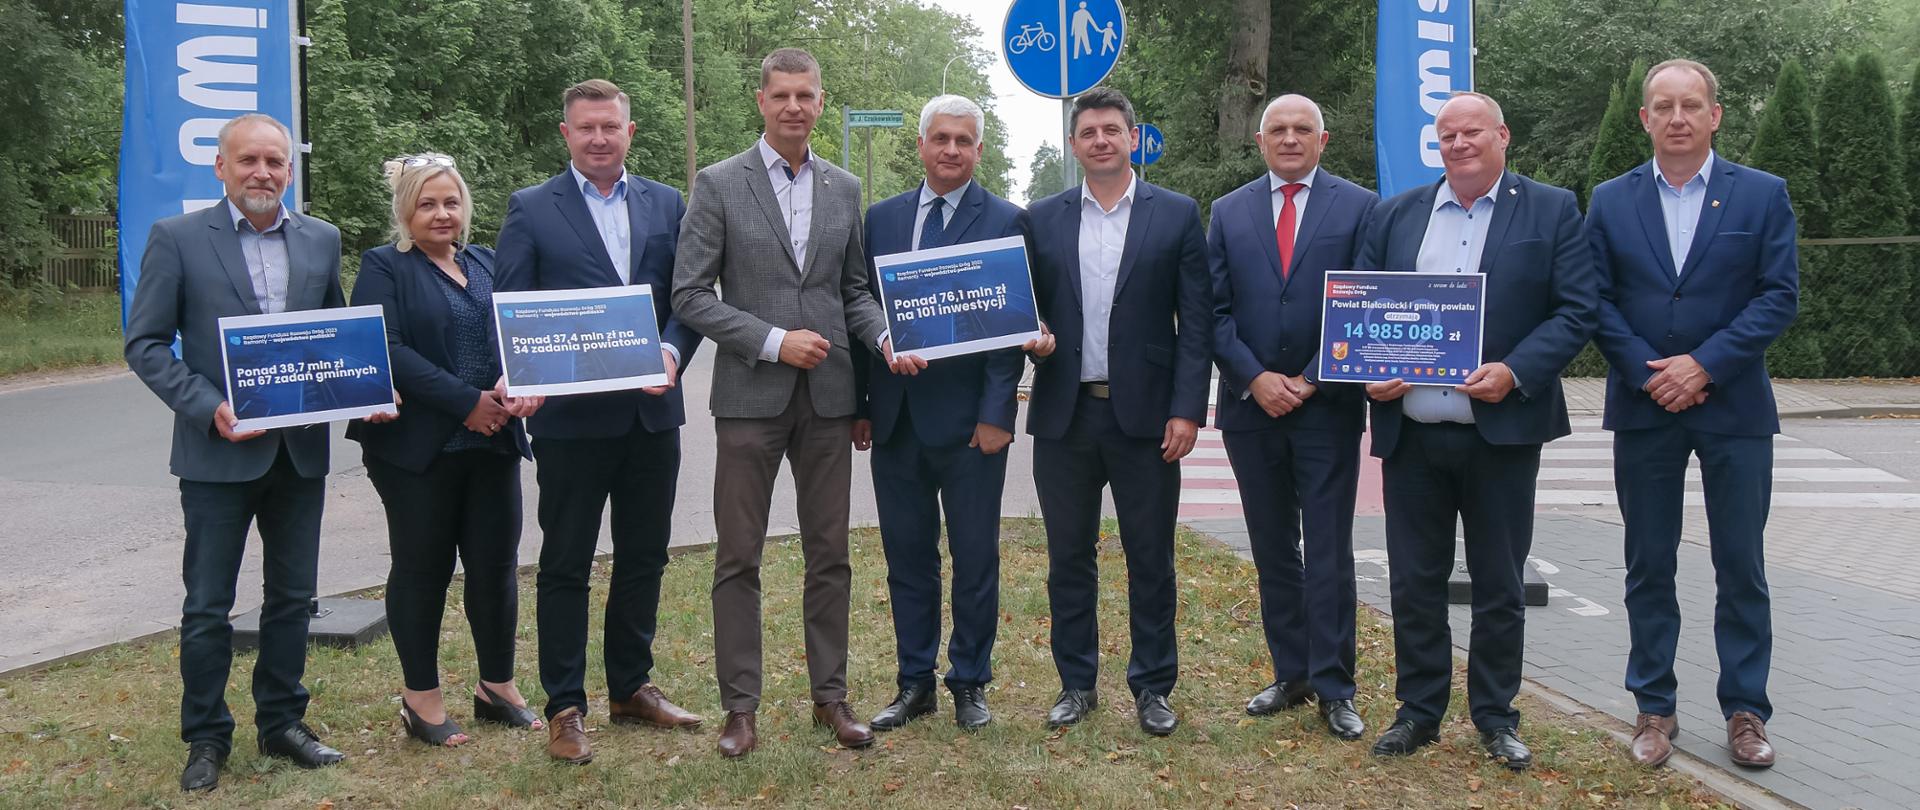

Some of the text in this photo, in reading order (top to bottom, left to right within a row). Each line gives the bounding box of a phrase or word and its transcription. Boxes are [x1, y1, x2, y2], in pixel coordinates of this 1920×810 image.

[894, 283, 1007, 310] Ponad 76,1 mln zł
[1332, 300, 1360, 309] Powiat
[1361, 300, 1407, 310] Białostocki
[1414, 302, 1439, 311] gminy
[1441, 303, 1475, 312] powiatu
[897, 294, 1007, 321] na 101 inwestycji
[512, 329, 635, 345] Ponad 37,4 mln zł na
[1344, 322, 1460, 341] 14 985 088 zł
[513, 337, 648, 354] 34 zadania powiatowe
[237, 358, 344, 378] Ponad 38,7 mln zł
[238, 365, 377, 388] na 67 zadań gminnych
